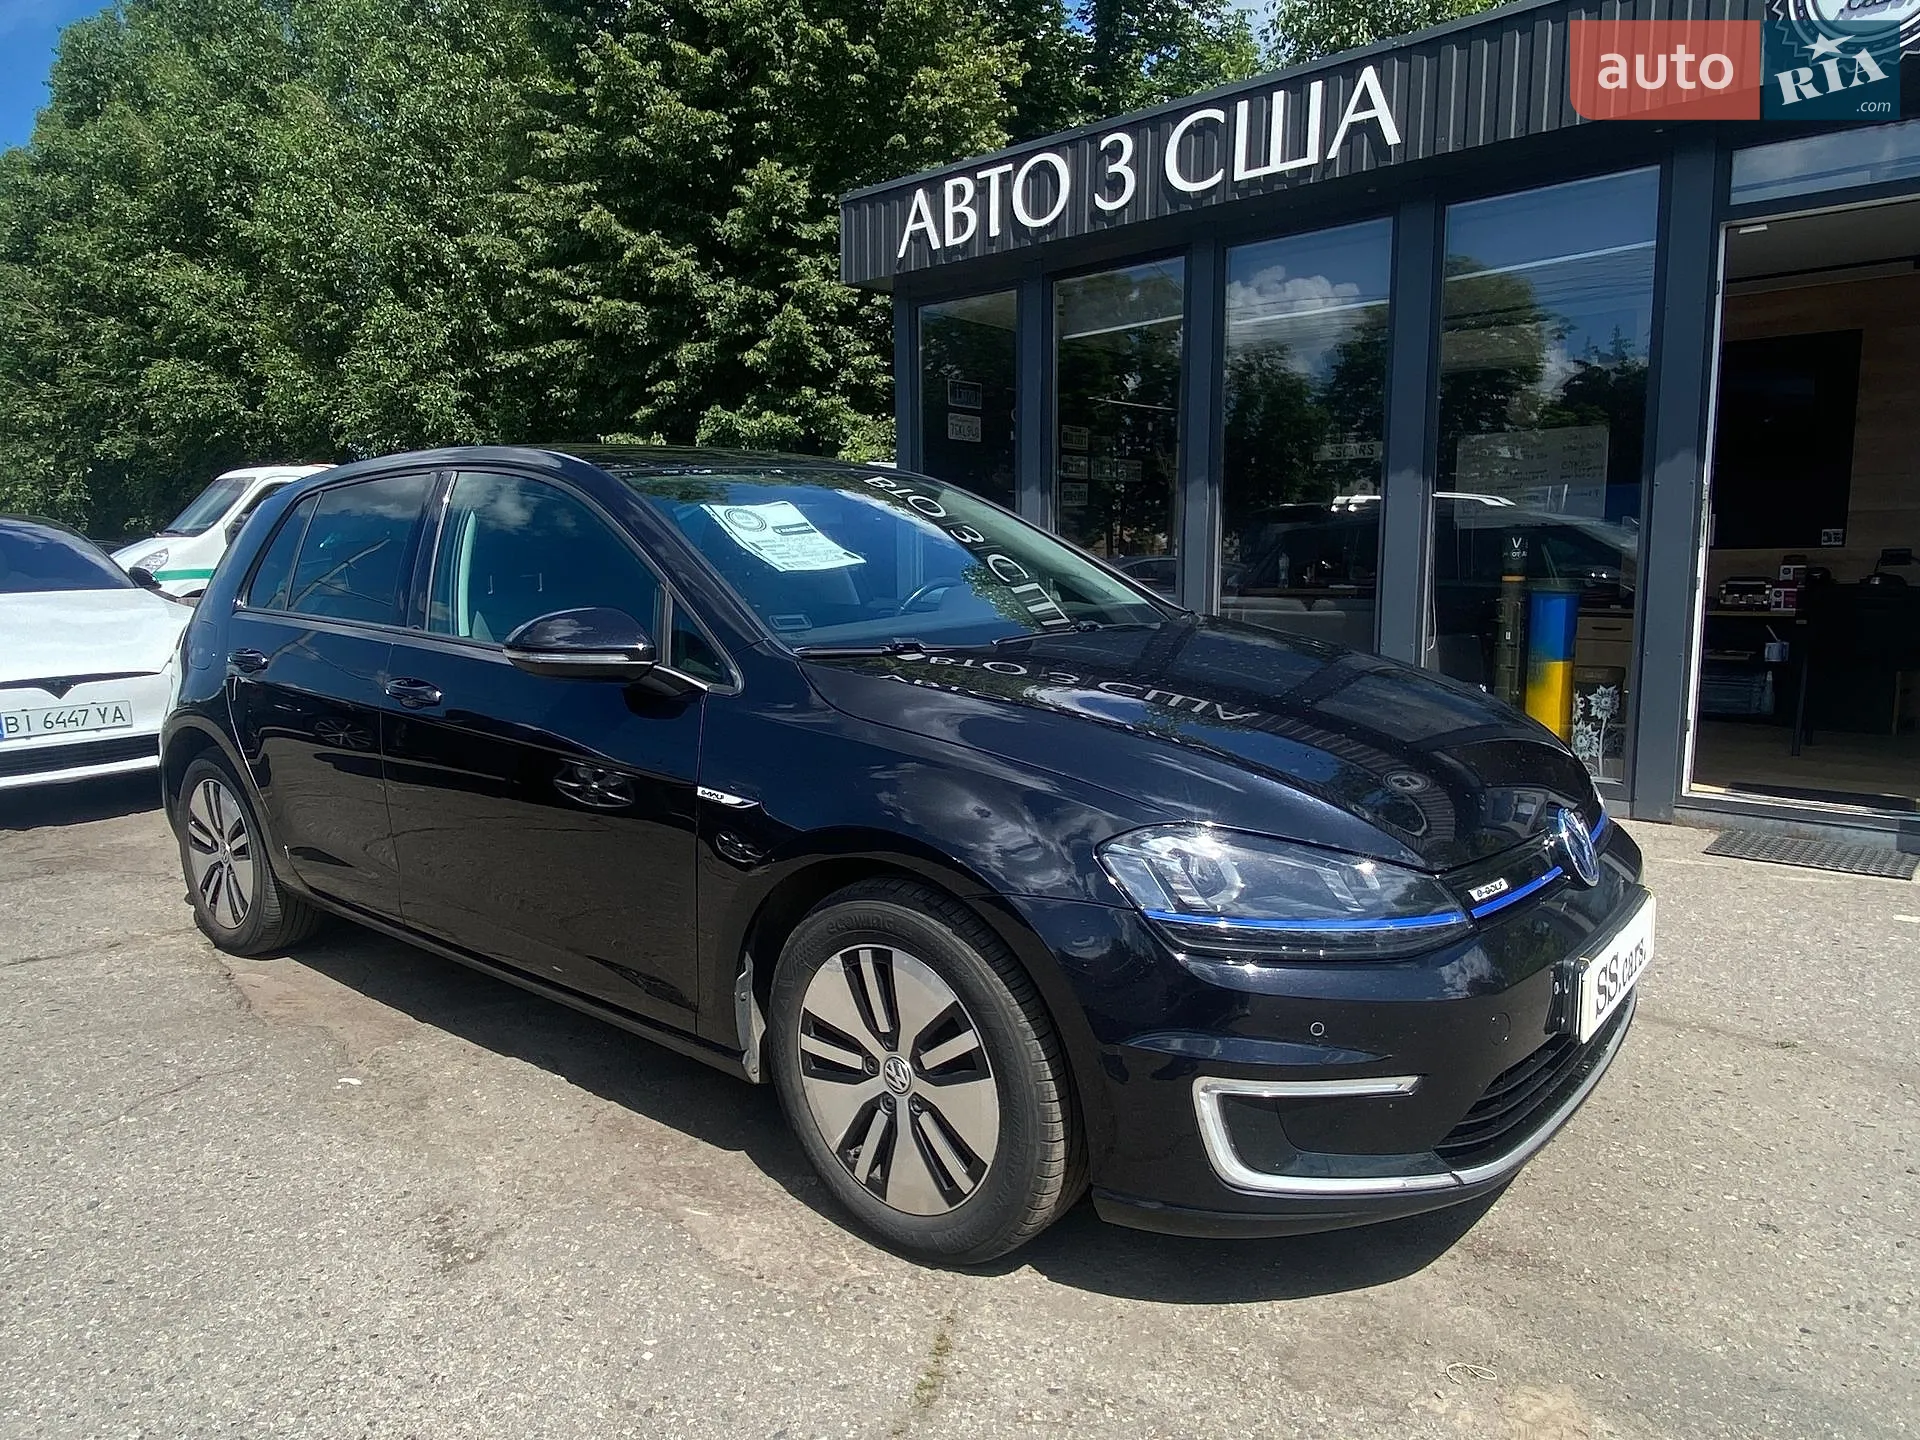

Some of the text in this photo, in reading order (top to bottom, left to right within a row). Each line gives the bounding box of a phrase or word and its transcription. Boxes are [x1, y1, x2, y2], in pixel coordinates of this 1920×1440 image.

[897, 152, 1070, 259] АВТО
[1164, 65, 1402, 194] США
[43, 709, 89, 730] 6447
[97, 706, 126, 724] YA
